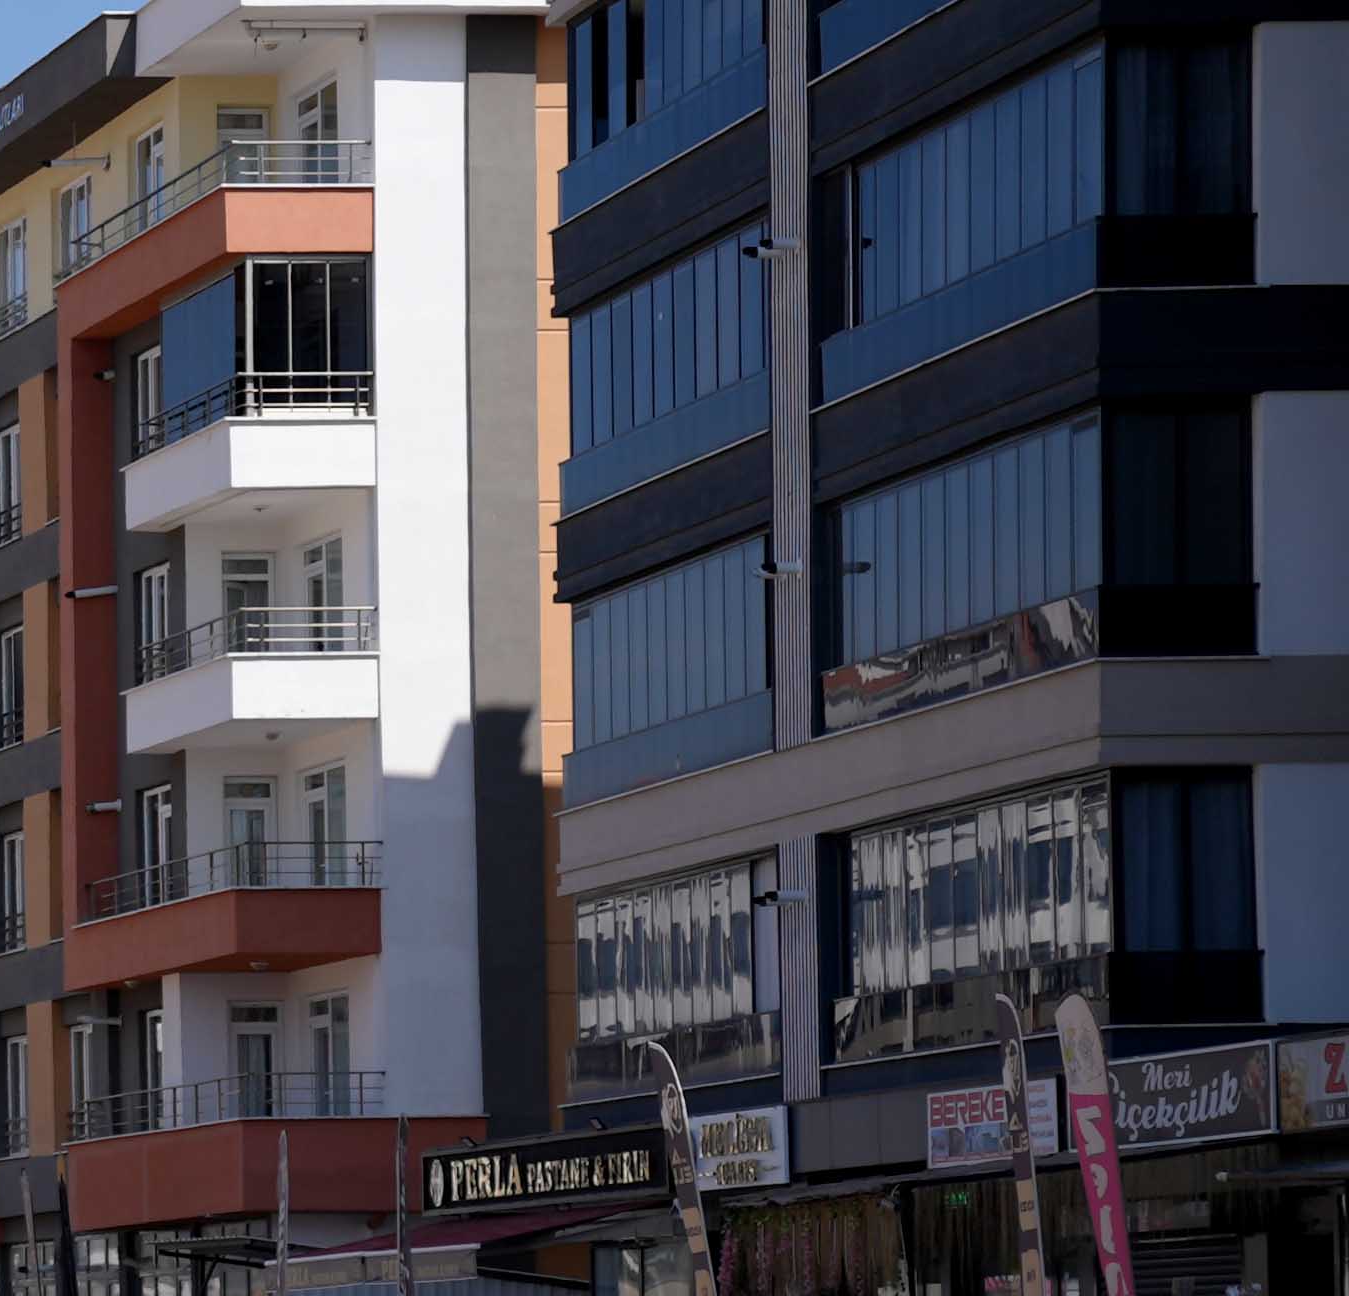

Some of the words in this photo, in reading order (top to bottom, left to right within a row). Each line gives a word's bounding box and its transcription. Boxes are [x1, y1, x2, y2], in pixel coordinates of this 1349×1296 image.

[1141, 1063, 1191, 1093] Meri
[930, 1089, 1006, 1127] BEREKE
[451, 1152, 525, 1200] PERLA
[526, 1158, 589, 1194] PASTANE
[592, 1156, 606, 1187] &
[607, 1150, 651, 1185] FIRIN
